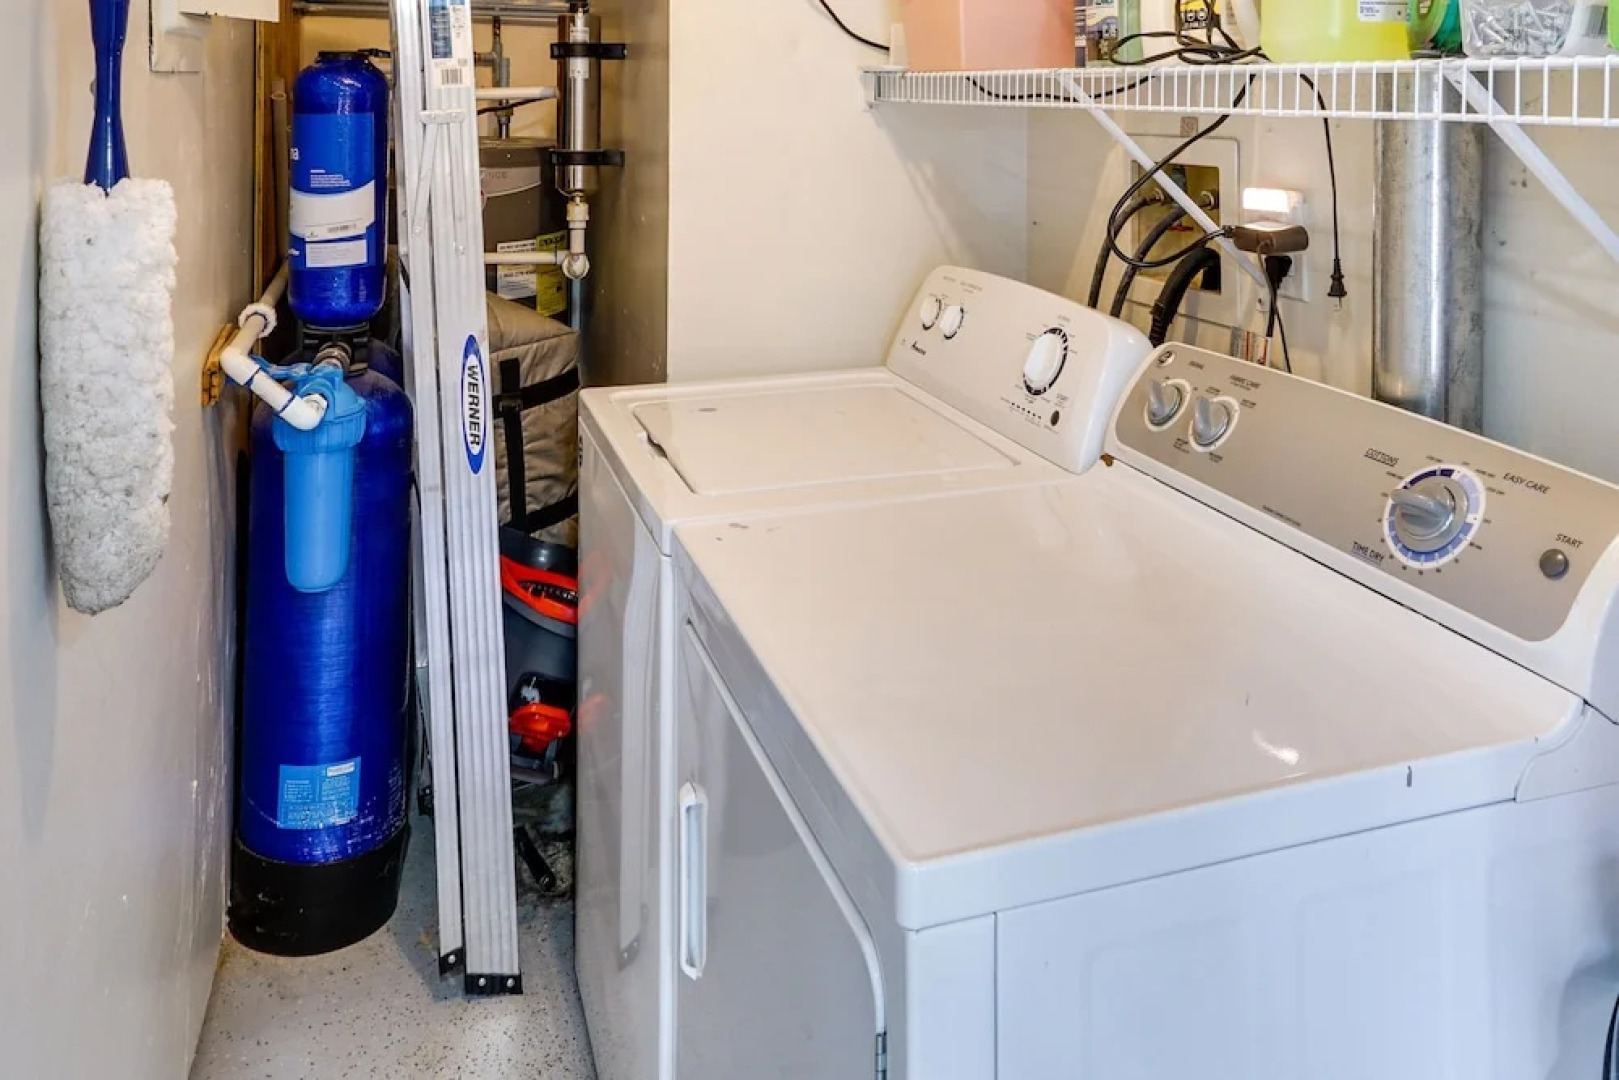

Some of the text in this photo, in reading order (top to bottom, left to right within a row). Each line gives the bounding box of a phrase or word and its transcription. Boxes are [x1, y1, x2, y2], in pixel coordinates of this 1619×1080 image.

[467, 364, 480, 446] WERNER
[1364, 448, 1399, 466] COTTONS
[1503, 472, 1527, 485] EASY
[1525, 480, 1551, 494] CARE
[1352, 540, 1385, 563] TIME DRY
[1555, 533, 1583, 550] START
